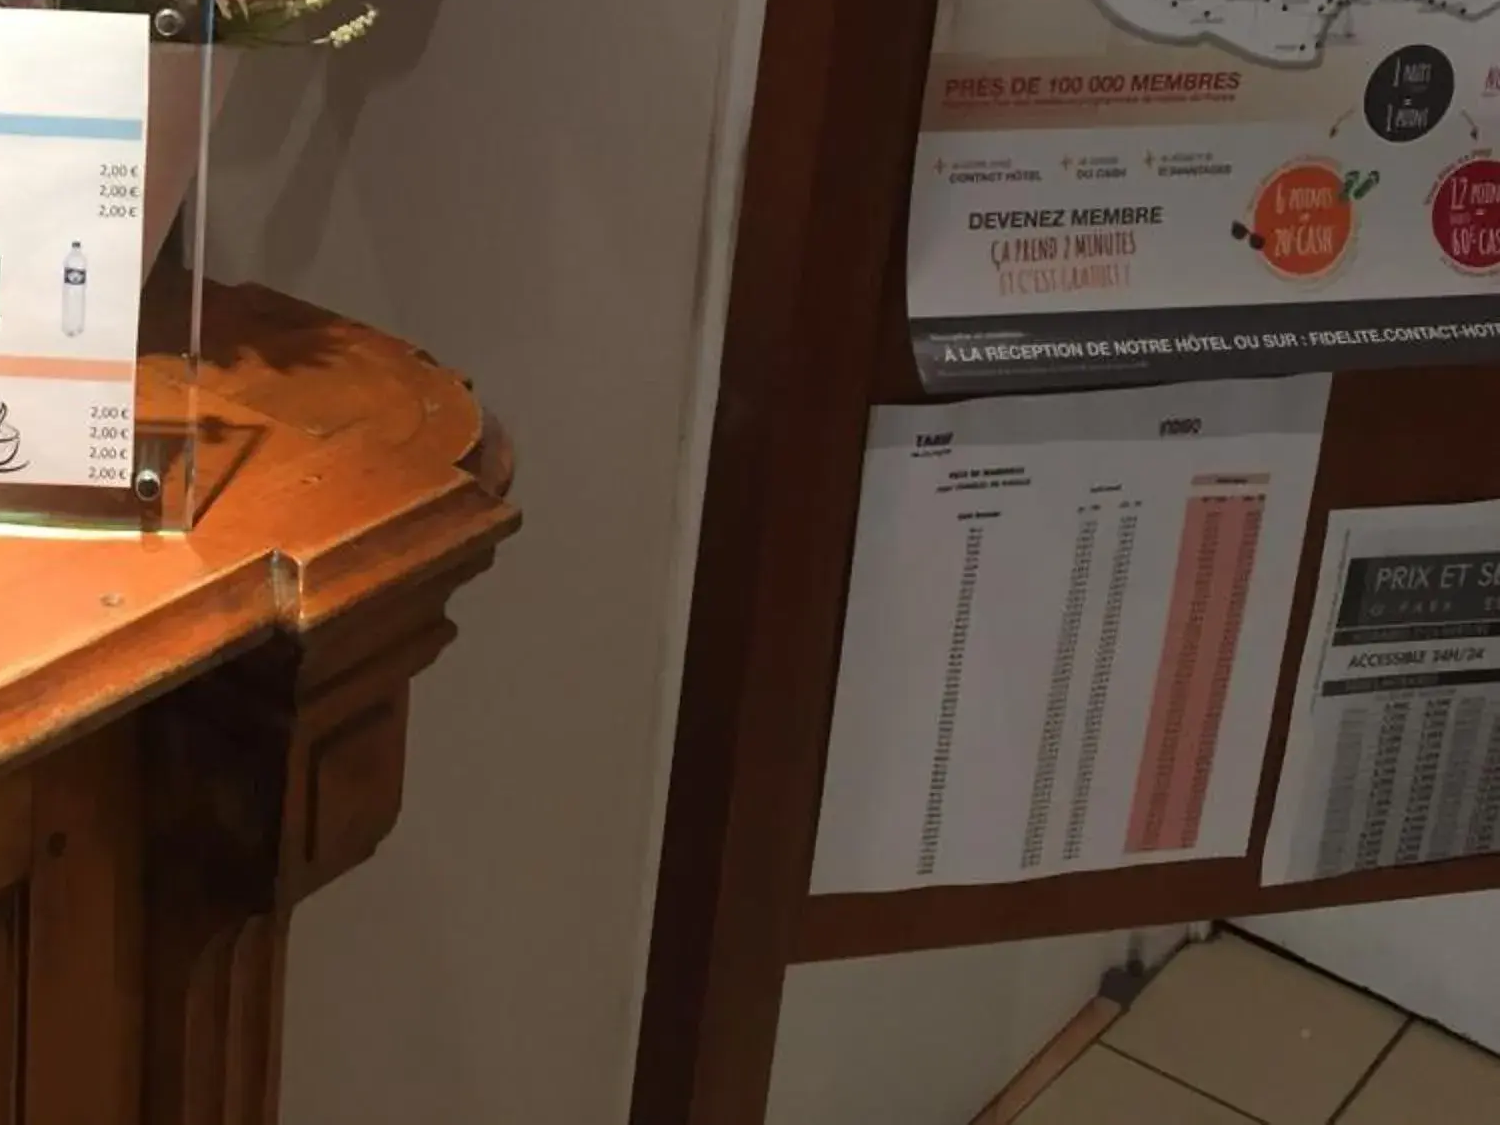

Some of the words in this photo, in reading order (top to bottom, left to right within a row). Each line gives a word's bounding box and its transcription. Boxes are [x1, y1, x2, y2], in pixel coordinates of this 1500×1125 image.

[1011, 75, 1042, 96] DE
[1050, 75, 1083, 95] 100
[1089, 73, 1126, 94] 000
[1131, 71, 1240, 93] MEMBRES
[100, 165, 128, 178] 2,00
[130, 165, 139, 178] €
[99, 186, 128, 199] 2,00
[130, 186, 140, 199] €
[99, 206, 127, 219] 2,00
[129, 206, 139, 219] €
[968, 209, 1065, 230] DEVENEZ
[1071, 206, 1164, 226] MEMBRE
[1297, 224, 1334, 256] CASH
[990, 240, 1011, 271] ÇA
[1015, 237, 1058, 264] PREND
[1075, 230, 1137, 258] MINUTES
[960, 345, 985, 363] LA
[1088, 339, 1112, 358] DE
[1114, 335, 1174, 357] NOTRE
[1234, 333, 1260, 352] OU
[1263, 332, 1299, 350] SUR
[90, 406, 119, 420] 2,00
[121, 407, 130, 420] €
[89, 427, 118, 440] 2,00
[120, 427, 129, 440] €
[89, 447, 117, 460] 2,00
[119, 447, 128, 460] €
[88, 467, 116, 480] 2,00
[118, 467, 128, 480] €
[1375, 565, 1433, 593] PRIX
[1440, 562, 1474, 589] ET
